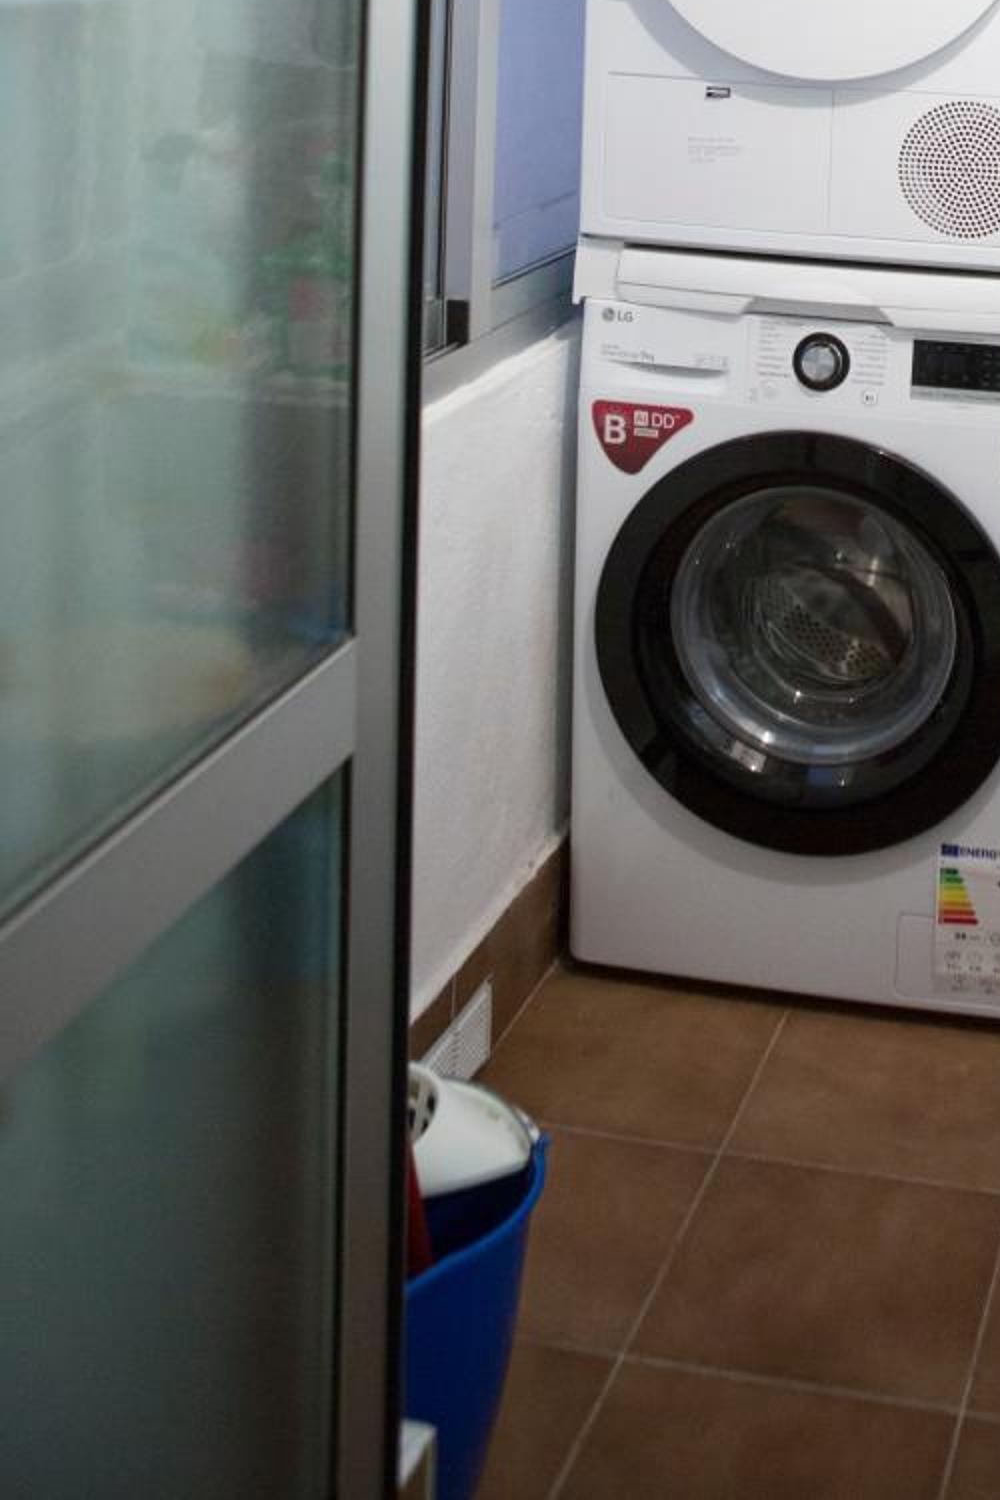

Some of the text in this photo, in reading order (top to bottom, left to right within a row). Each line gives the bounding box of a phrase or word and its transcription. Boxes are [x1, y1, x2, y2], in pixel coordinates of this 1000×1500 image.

[617, 310, 634, 323] LG
[604, 414, 627, 444] B
[651, 412, 675, 429] DD
